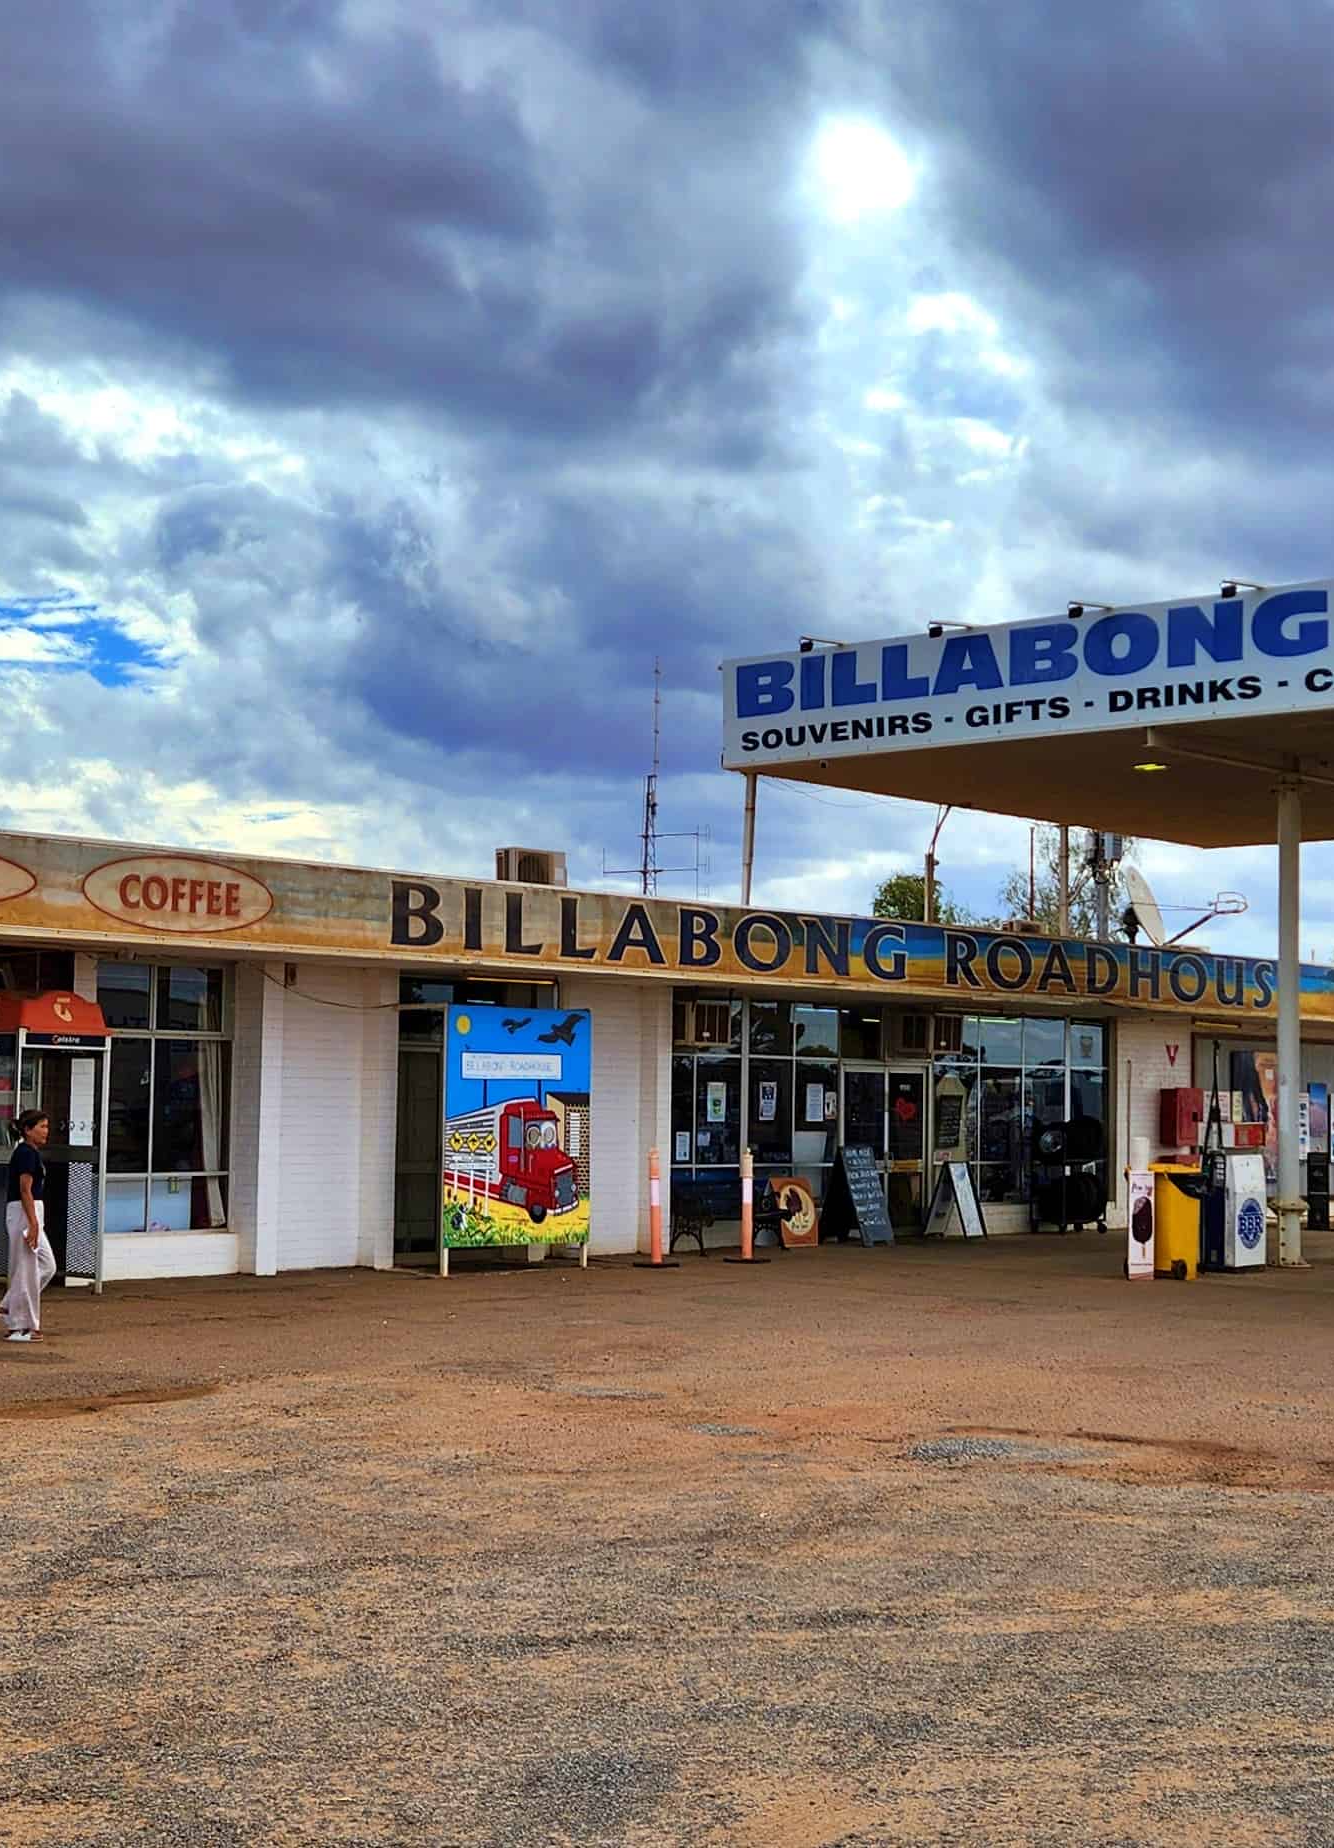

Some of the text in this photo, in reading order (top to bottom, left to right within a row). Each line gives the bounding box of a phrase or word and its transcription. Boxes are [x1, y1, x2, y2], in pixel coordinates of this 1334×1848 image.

[736, 590, 1329, 718] BILLABONG
[741, 711, 933, 751] SOUVENIRS
[965, 696, 1071, 728] GIFTS
[1108, 675, 1263, 713] DRINKS
[118, 873, 241, 917] COFFEE
[390, 879, 1274, 1009] BILLABONG ROADHOUS
